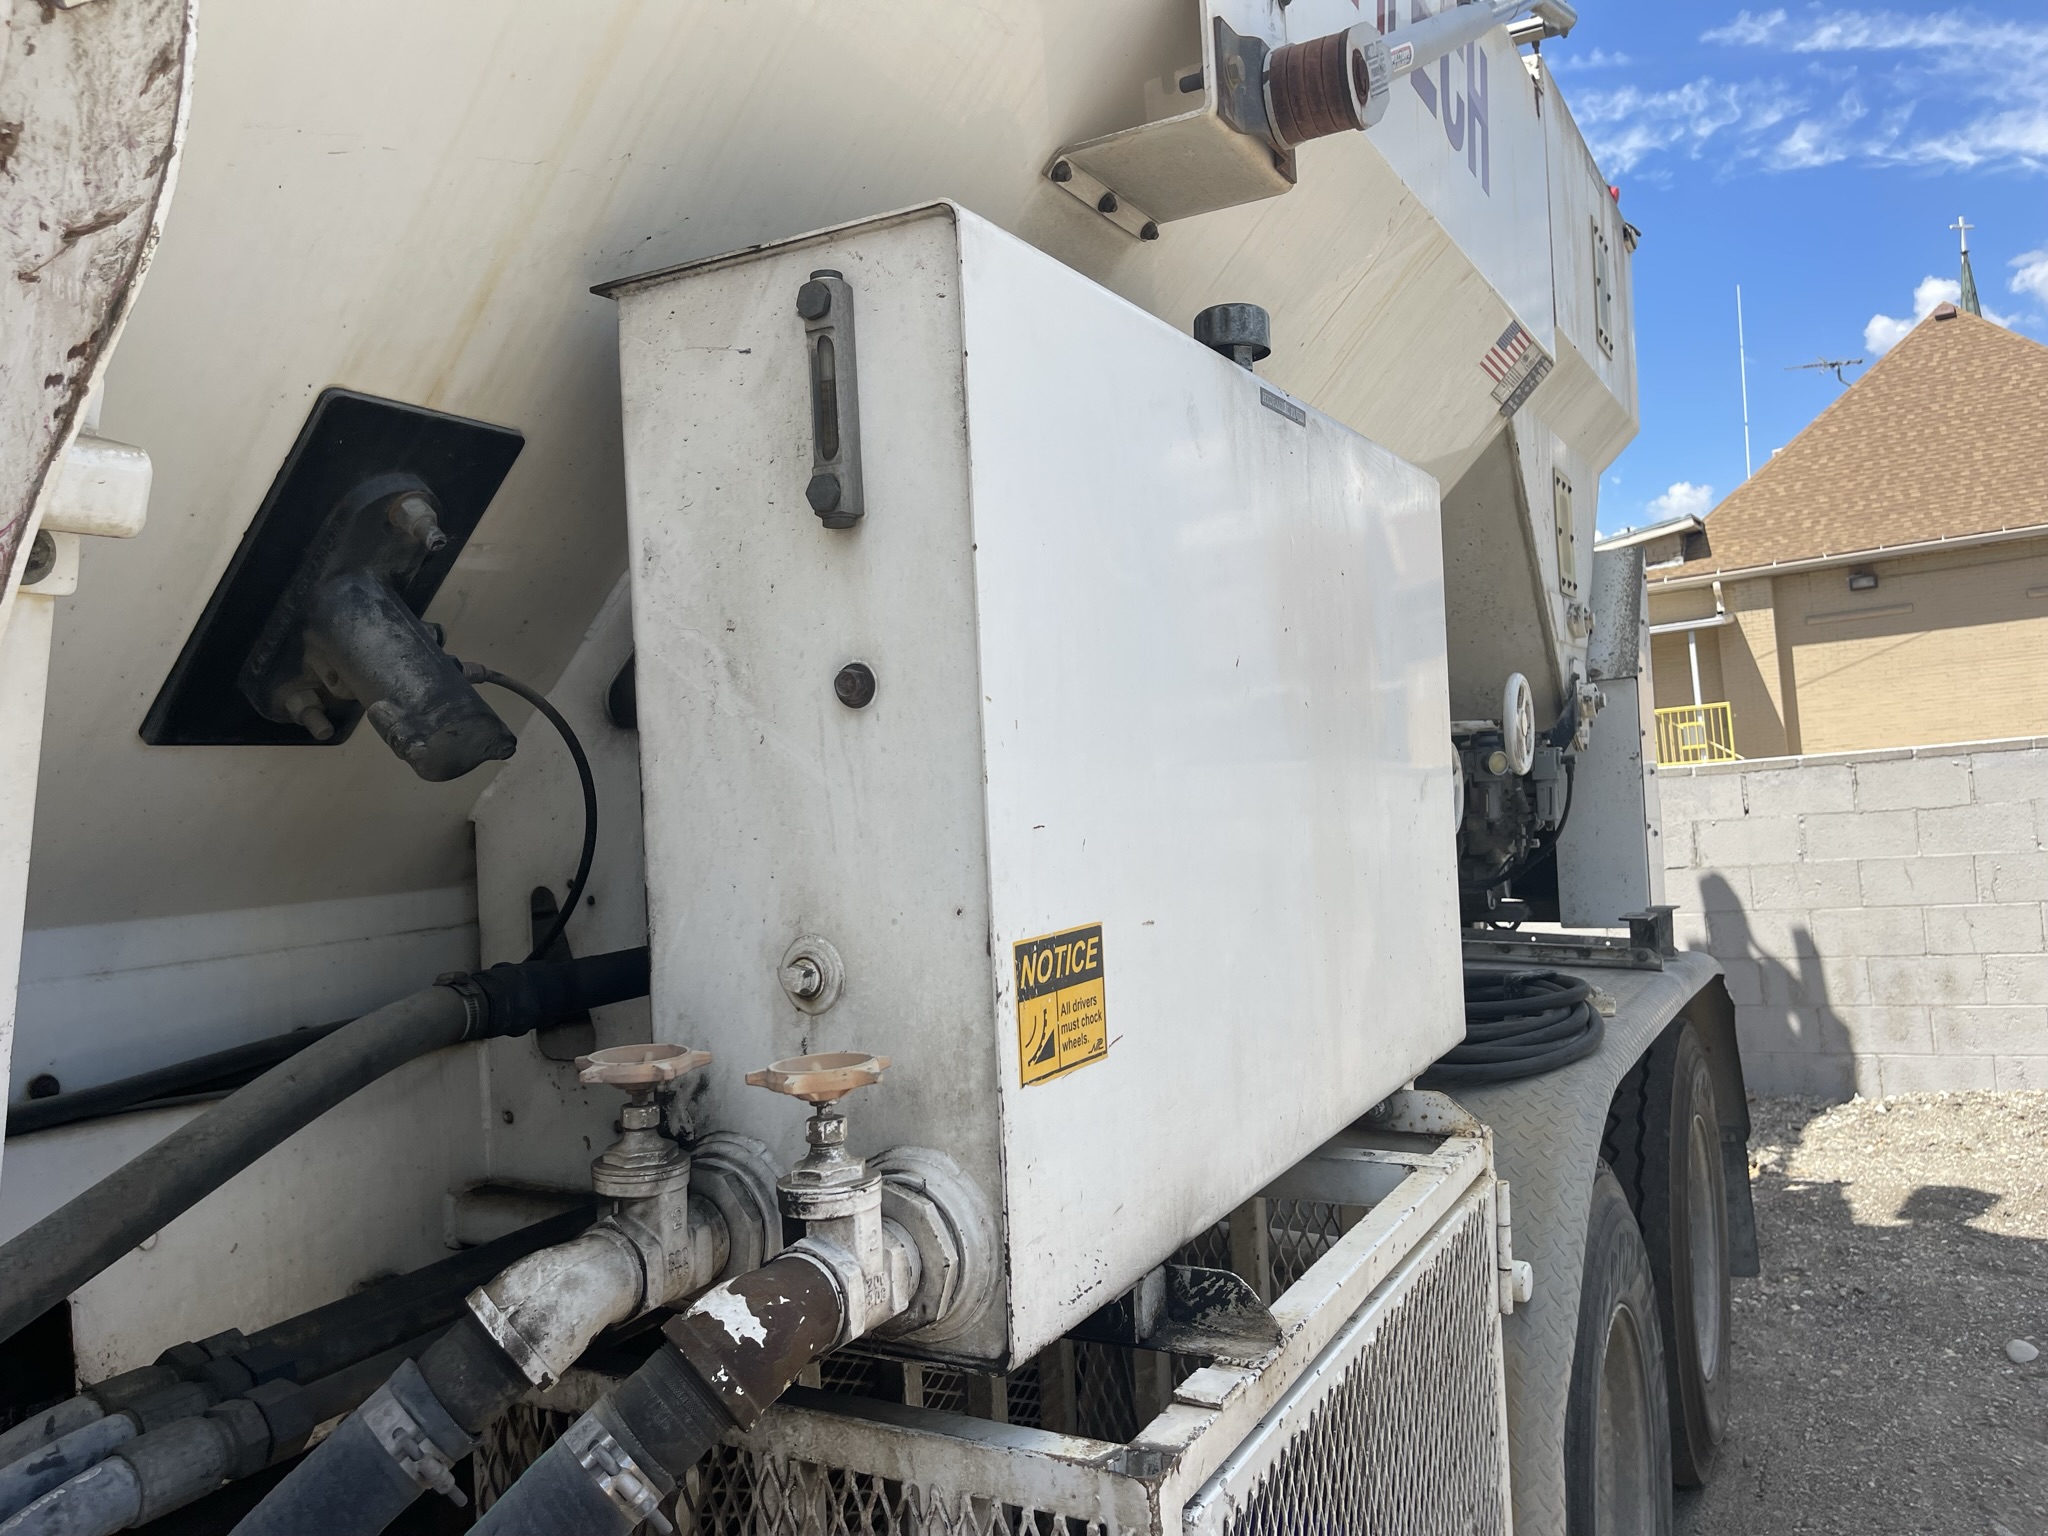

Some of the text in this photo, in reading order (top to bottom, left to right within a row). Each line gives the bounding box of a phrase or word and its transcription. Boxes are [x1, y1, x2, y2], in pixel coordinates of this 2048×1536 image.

[1020, 936, 1099, 989] NOTICE
[1060, 996, 1098, 1017] All drivers
[1061, 1009, 1103, 1035] must chock
[1062, 1033, 1090, 1052] wheels.
